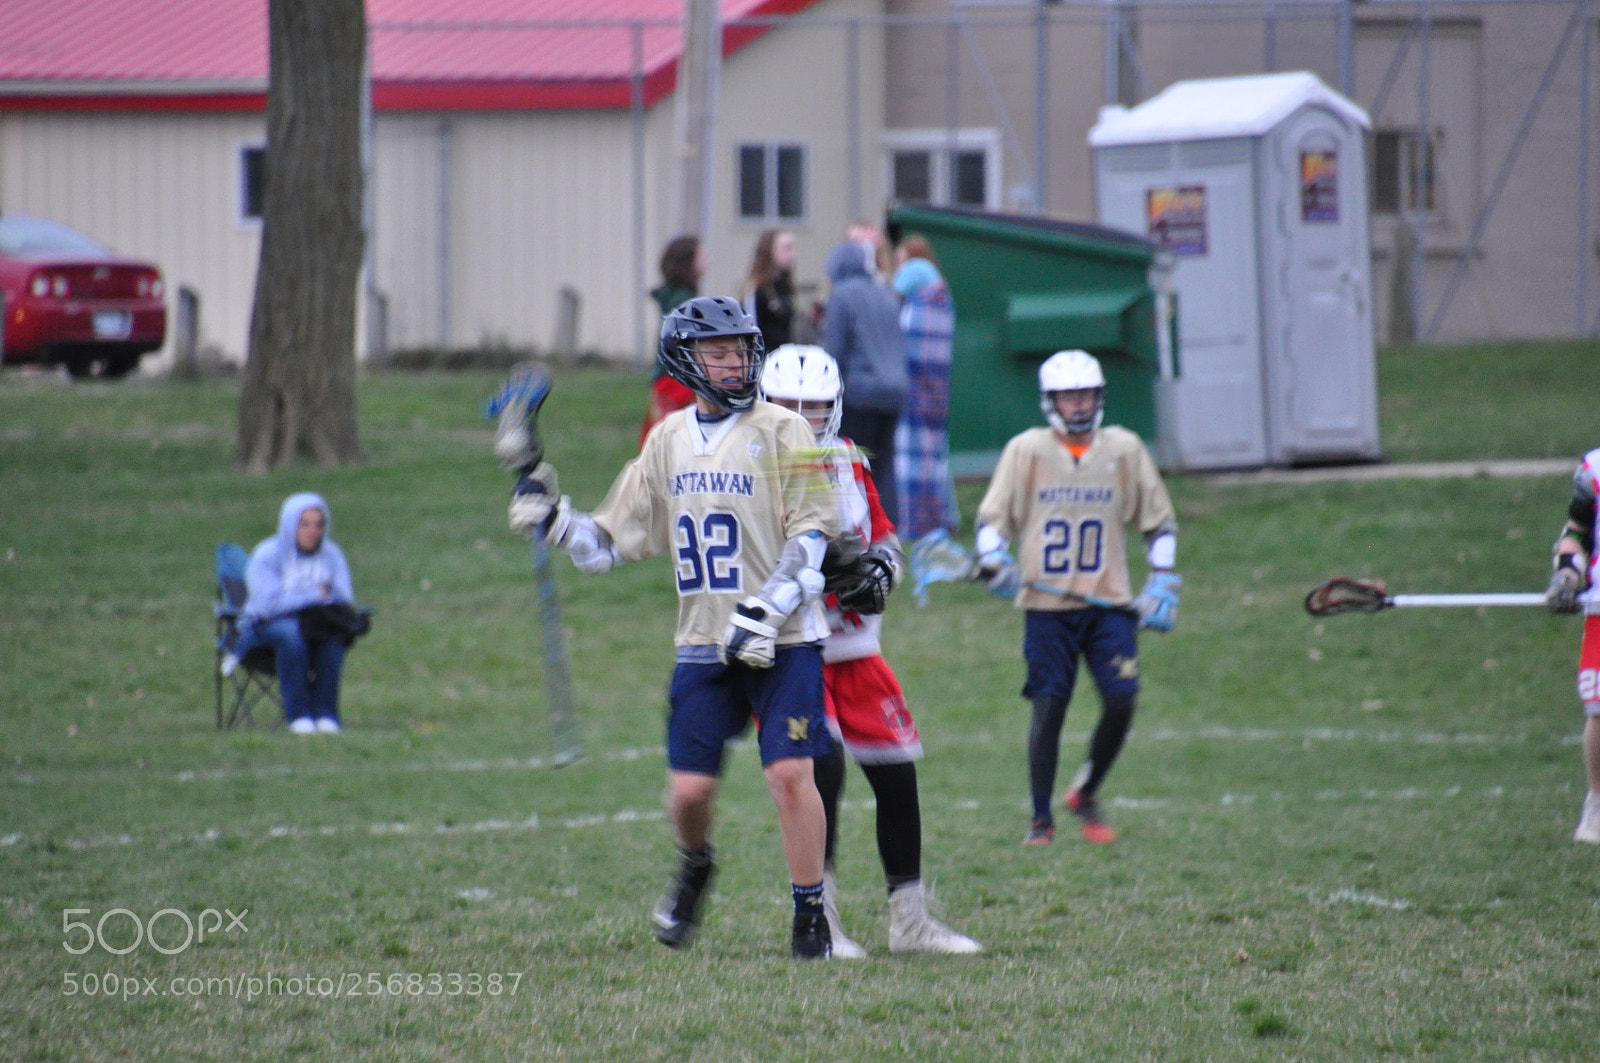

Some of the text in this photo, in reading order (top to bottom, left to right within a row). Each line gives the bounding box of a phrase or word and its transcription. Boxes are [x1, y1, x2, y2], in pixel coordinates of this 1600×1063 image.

[670, 471, 756, 498] ATTAWAN
[677, 511, 743, 595] 32
[1043, 518, 1104, 575] 20
